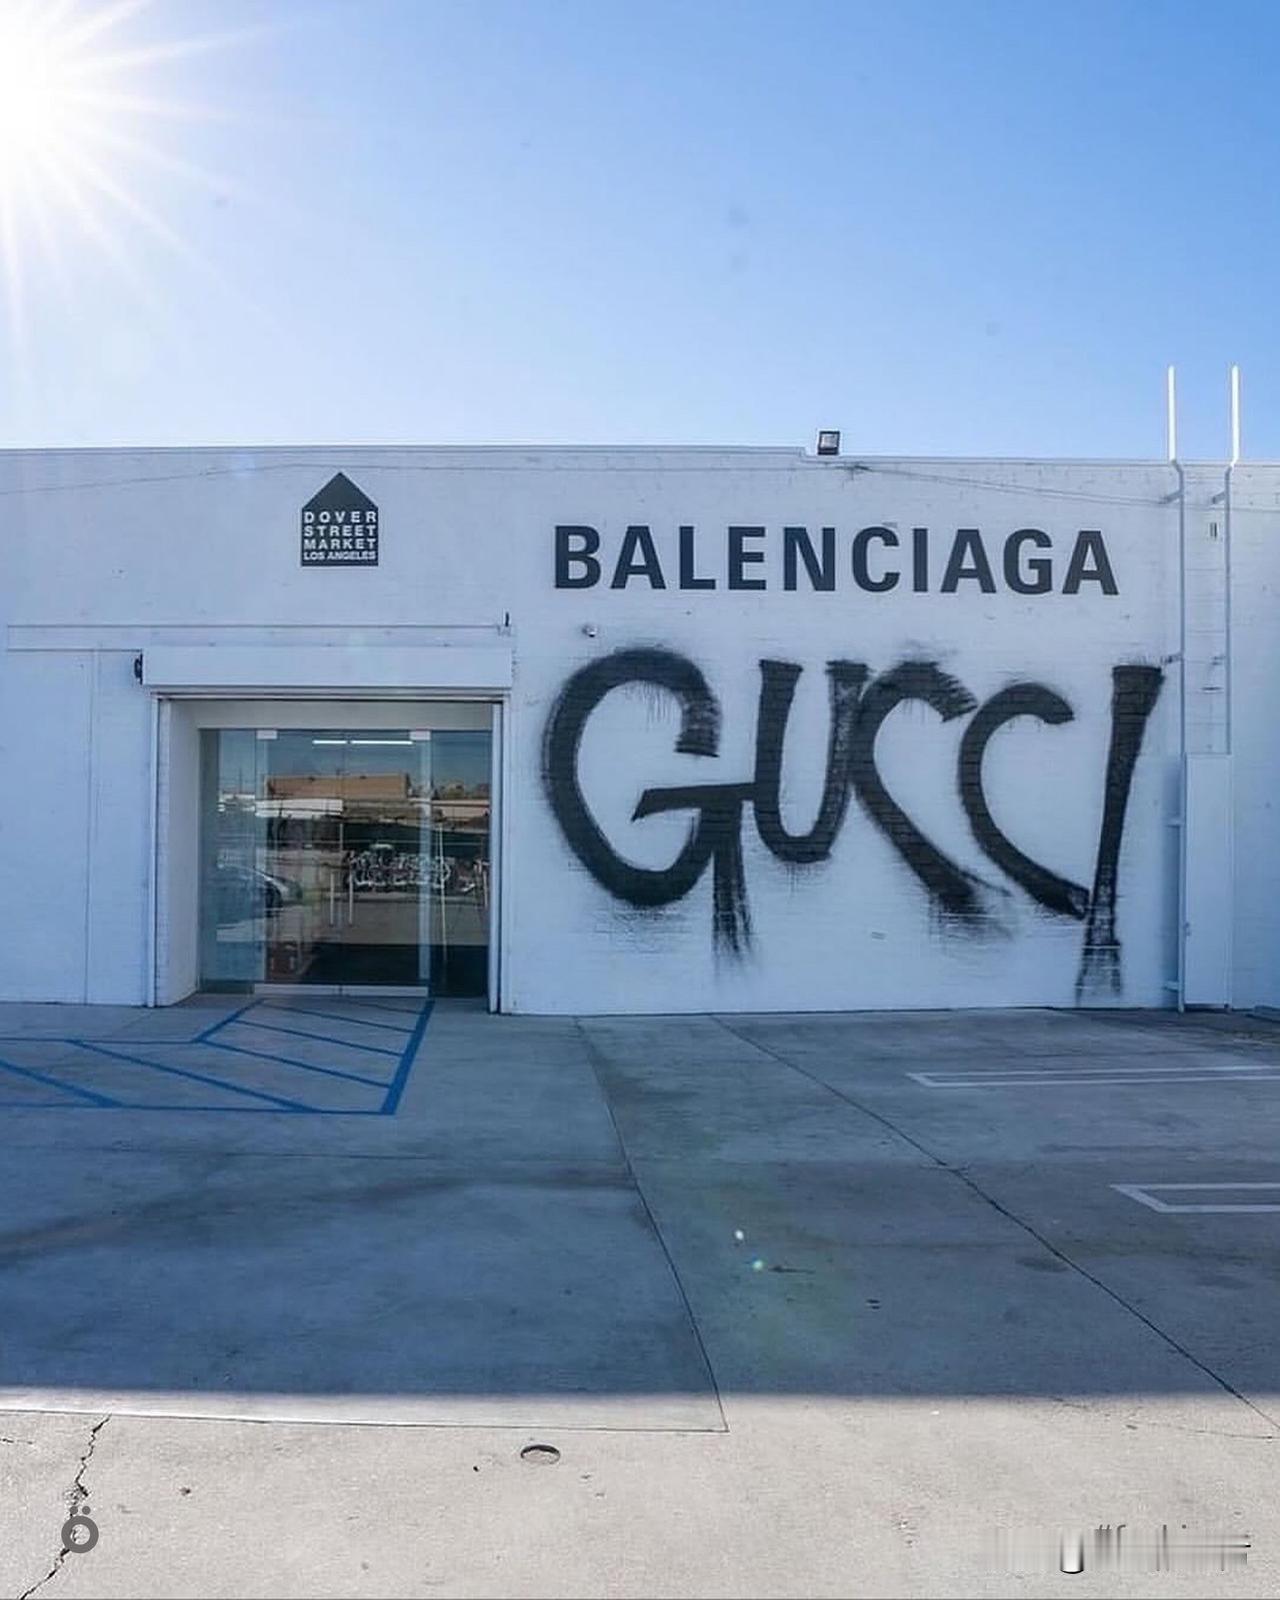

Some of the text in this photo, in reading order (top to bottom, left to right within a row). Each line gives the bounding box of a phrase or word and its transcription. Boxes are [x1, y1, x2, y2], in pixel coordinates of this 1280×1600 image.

[303, 511, 377, 523] DOVER
[303, 525, 377, 537] STREET
[303, 538, 377, 550] MARKET
[303, 551, 376, 560] LOS ANGELES
[554, 525, 1120, 596] BALENCIAGA
[540, 645, 1164, 1003] GUCCI
